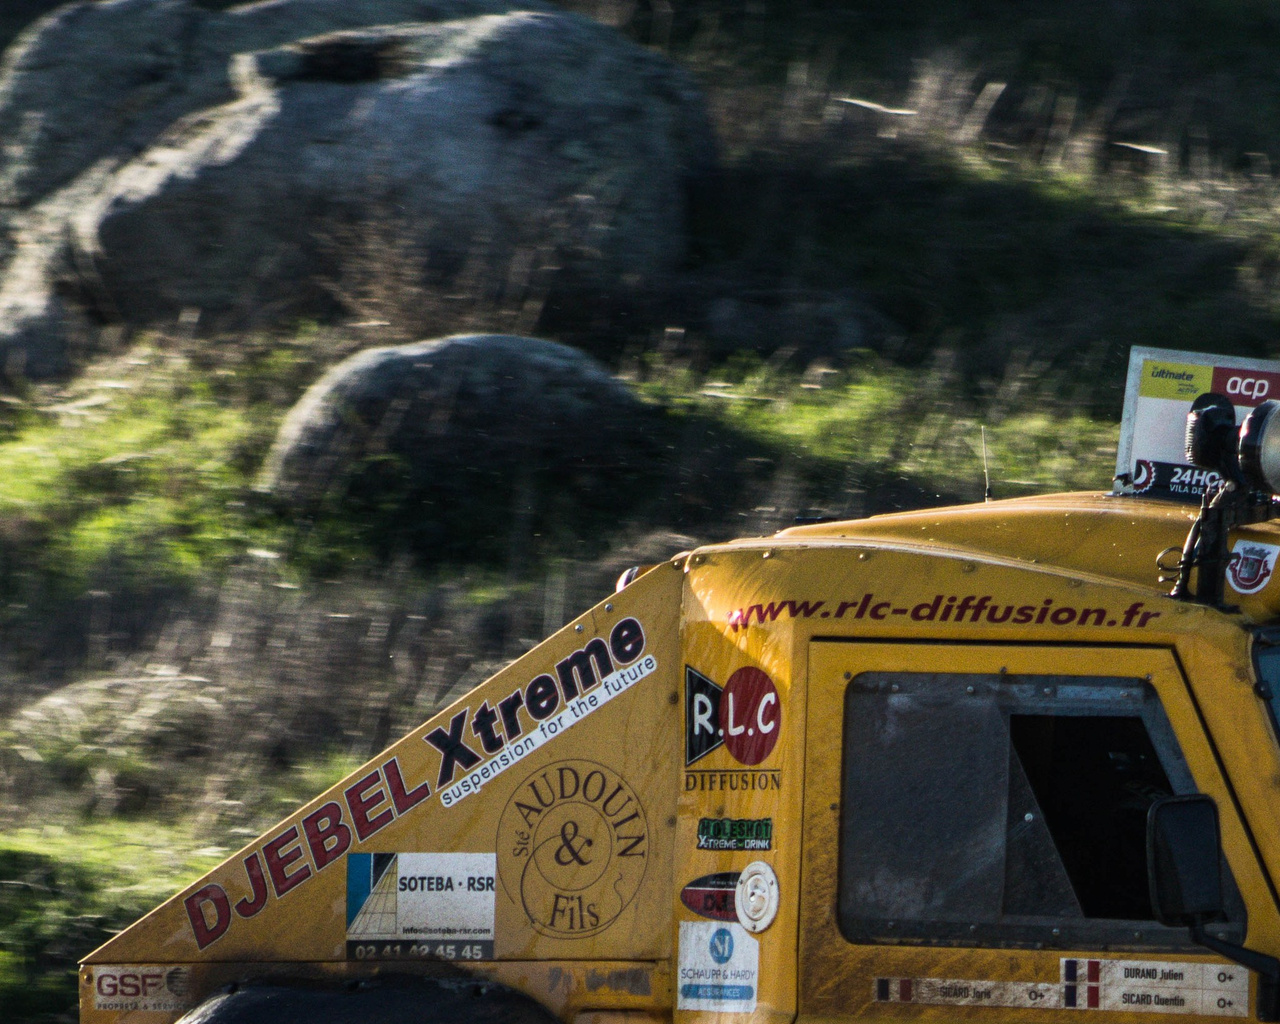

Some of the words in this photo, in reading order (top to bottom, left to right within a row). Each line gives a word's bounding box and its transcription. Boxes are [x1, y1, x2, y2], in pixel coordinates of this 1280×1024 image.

[1151, 367, 1194, 382] ultimate
[1226, 376, 1269, 399] acp
[1169, 484, 1189, 494] VILA
[1191, 487, 1204, 495] DE
[725, 594, 1161, 632] www.rlc-diffusion.fr
[423, 617, 645, 791] Xtreme
[442, 735, 534, 807] suspension
[540, 716, 564, 738] for
[570, 694, 598, 719] the
[604, 656, 655, 696] future
[685, 773, 781, 791] DIFFUSION
[514, 766, 645, 858] AUDOUIN
[700, 819, 771, 838] HOLESHOT
[513, 830, 530, 857] Sté
[554, 820, 593, 866] &
[744, 839, 769, 849] DRINK
[184, 757, 431, 951] DJEBEL
[399, 876, 454, 892] SOTEBA
[467, 877, 495, 892] RSR
[549, 893, 600, 930] Fils
[355, 945, 376, 959] 02
[434, 945, 456, 959] 45
[461, 945, 482, 959] 45
[681, 968, 721, 980] SCHAUPP
[722, 970, 729, 980] &
[730, 970, 756, 981] HARDY
[1124, 966, 1158, 981] DURAND
[1159, 968, 1184, 982] Julien
[97, 974, 163, 997] GSF
[940, 986, 969, 998] SICARD
[1122, 993, 1151, 1006] SICARD
[1153, 994, 1185, 1008] Quentin
